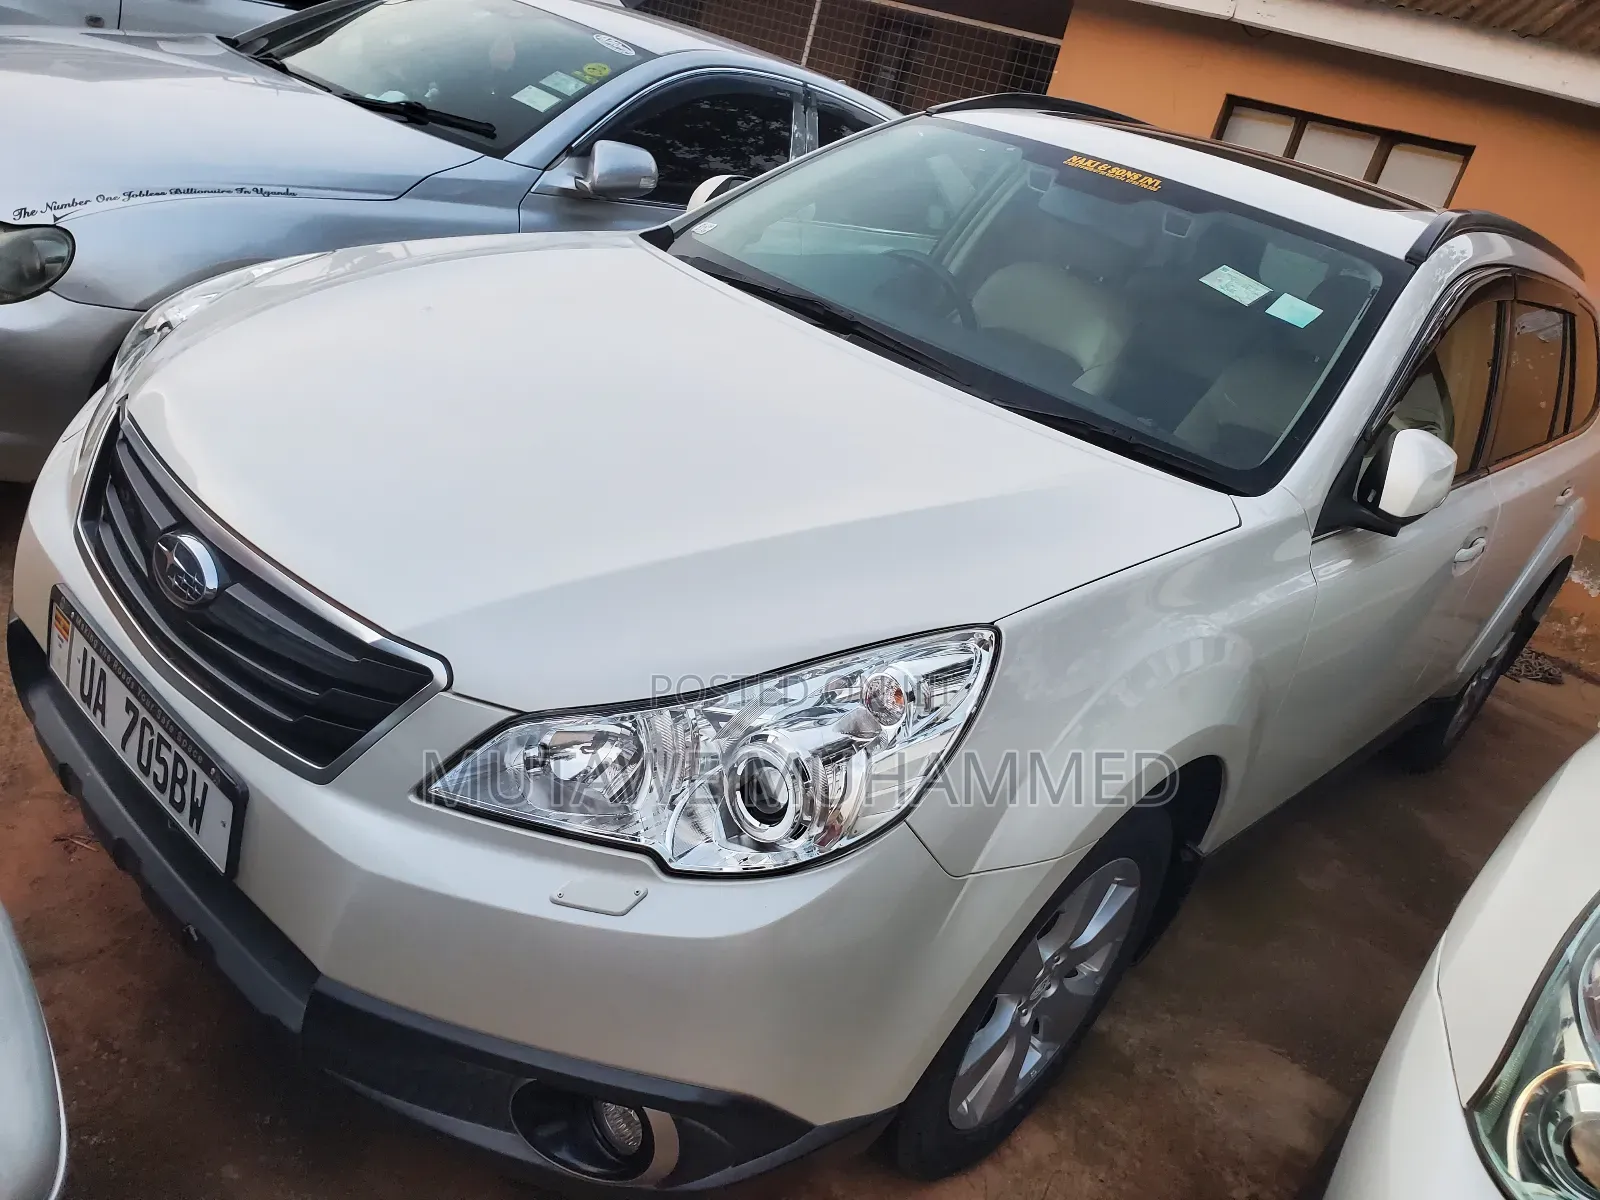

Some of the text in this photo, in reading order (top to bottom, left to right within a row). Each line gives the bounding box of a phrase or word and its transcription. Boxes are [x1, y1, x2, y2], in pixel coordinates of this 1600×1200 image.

[12, 207, 38, 221] The
[40, 198, 92, 214] Number
[95, 194, 121, 203] One
[122, 189, 167, 202] Jobless
[252, 187, 298, 198] Uganda
[1066, 155, 1101, 169] NAKI
[1097, 163, 1111, 171] &
[1108, 166, 1142, 180] SONS
[76, 614, 98, 649] Making
[113, 660, 135, 689] Roads
[137, 687, 156, 713] Your
[156, 708, 174, 732] Safe
[176, 731, 204, 764] Space
[79, 646, 209, 836] UA 705BW
